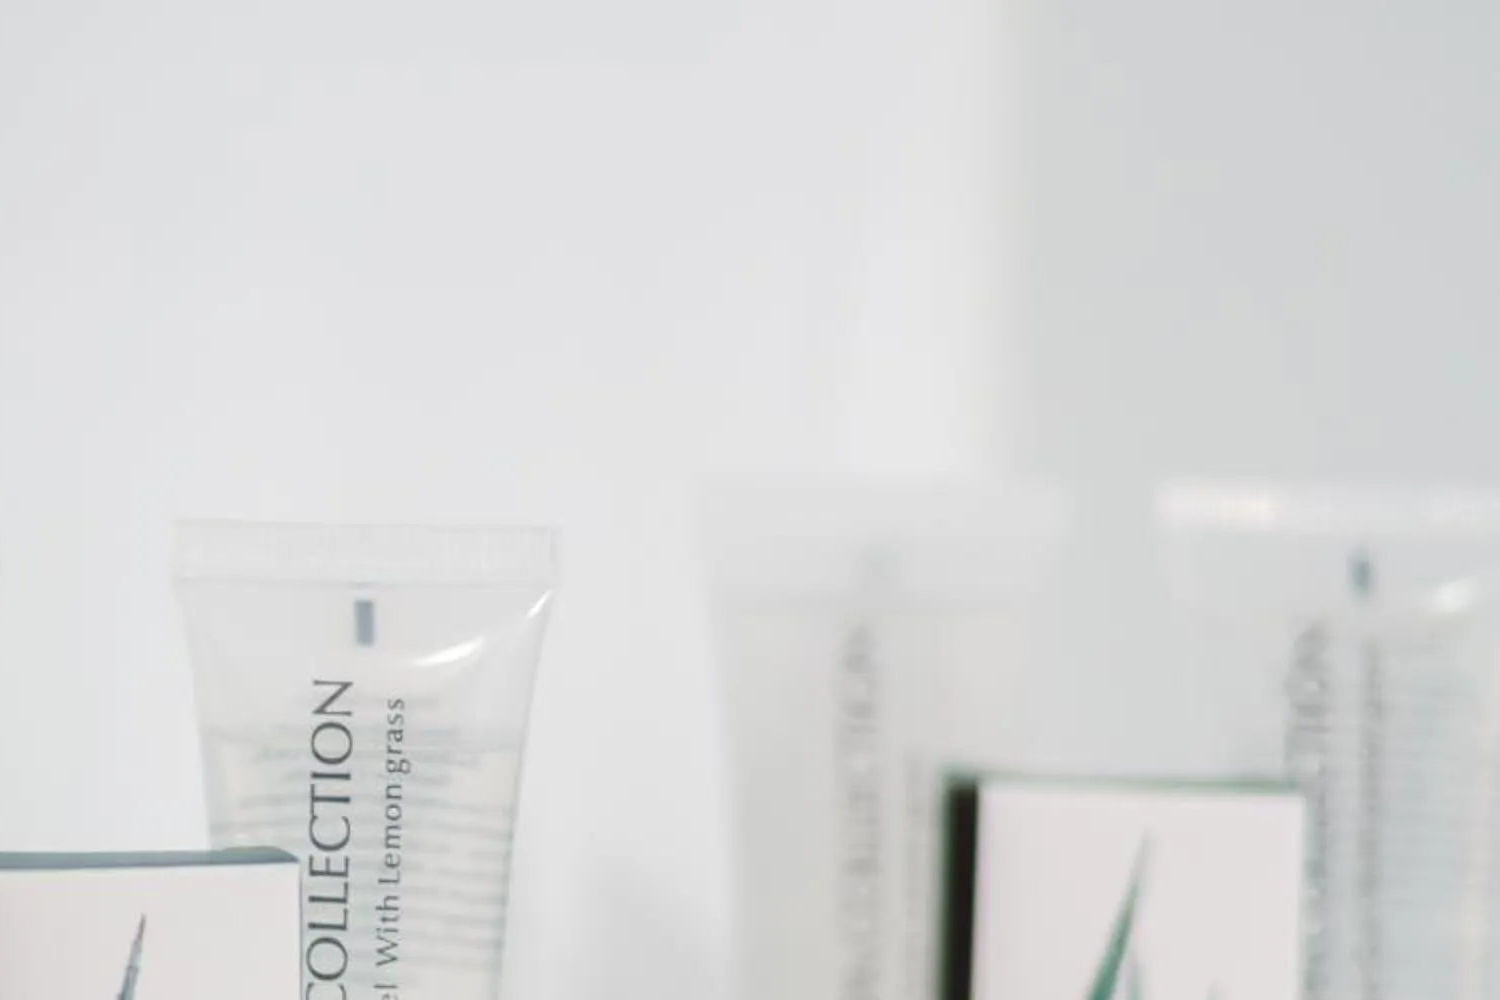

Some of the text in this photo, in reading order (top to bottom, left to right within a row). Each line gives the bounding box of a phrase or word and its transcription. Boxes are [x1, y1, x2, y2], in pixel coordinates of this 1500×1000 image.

[381, 697, 410, 773] grass
[377, 782, 404, 885] Lemon
[375, 893, 402, 966] With
